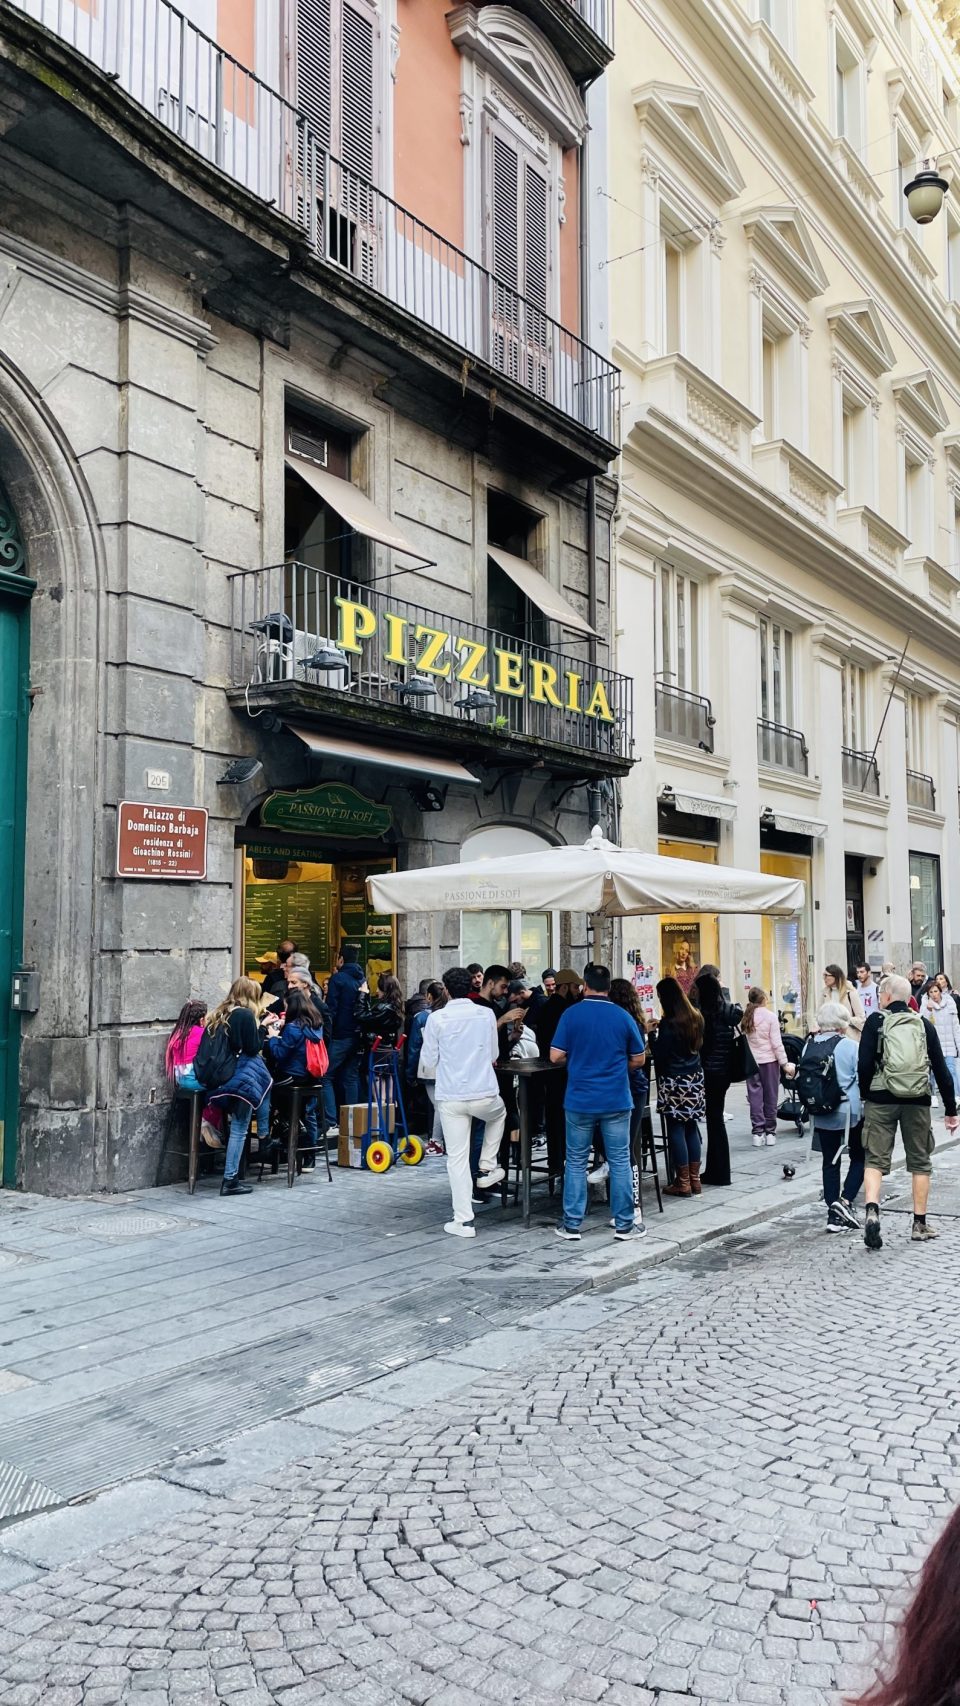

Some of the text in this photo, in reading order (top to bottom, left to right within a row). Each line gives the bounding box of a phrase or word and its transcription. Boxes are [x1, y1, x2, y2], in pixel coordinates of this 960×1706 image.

[334, 596, 615, 723] PIZZERIA
[150, 774, 167, 786] 205
[143, 808, 185, 822] Palazzo di
[289, 802, 337, 818] PASSIONE
[339, 809, 350, 819] DI
[127, 820, 199, 837] Domenico Barbaja
[143, 837, 183, 848] residenza di
[132, 847, 191, 858] Gioachino Rossini
[273, 847, 291, 857] AND
[293, 849, 323, 858] SEATING
[444, 890, 487, 901] PASSIONE
[489, 890, 499, 900] DI
[664, 924, 697, 932] goldenpoint
